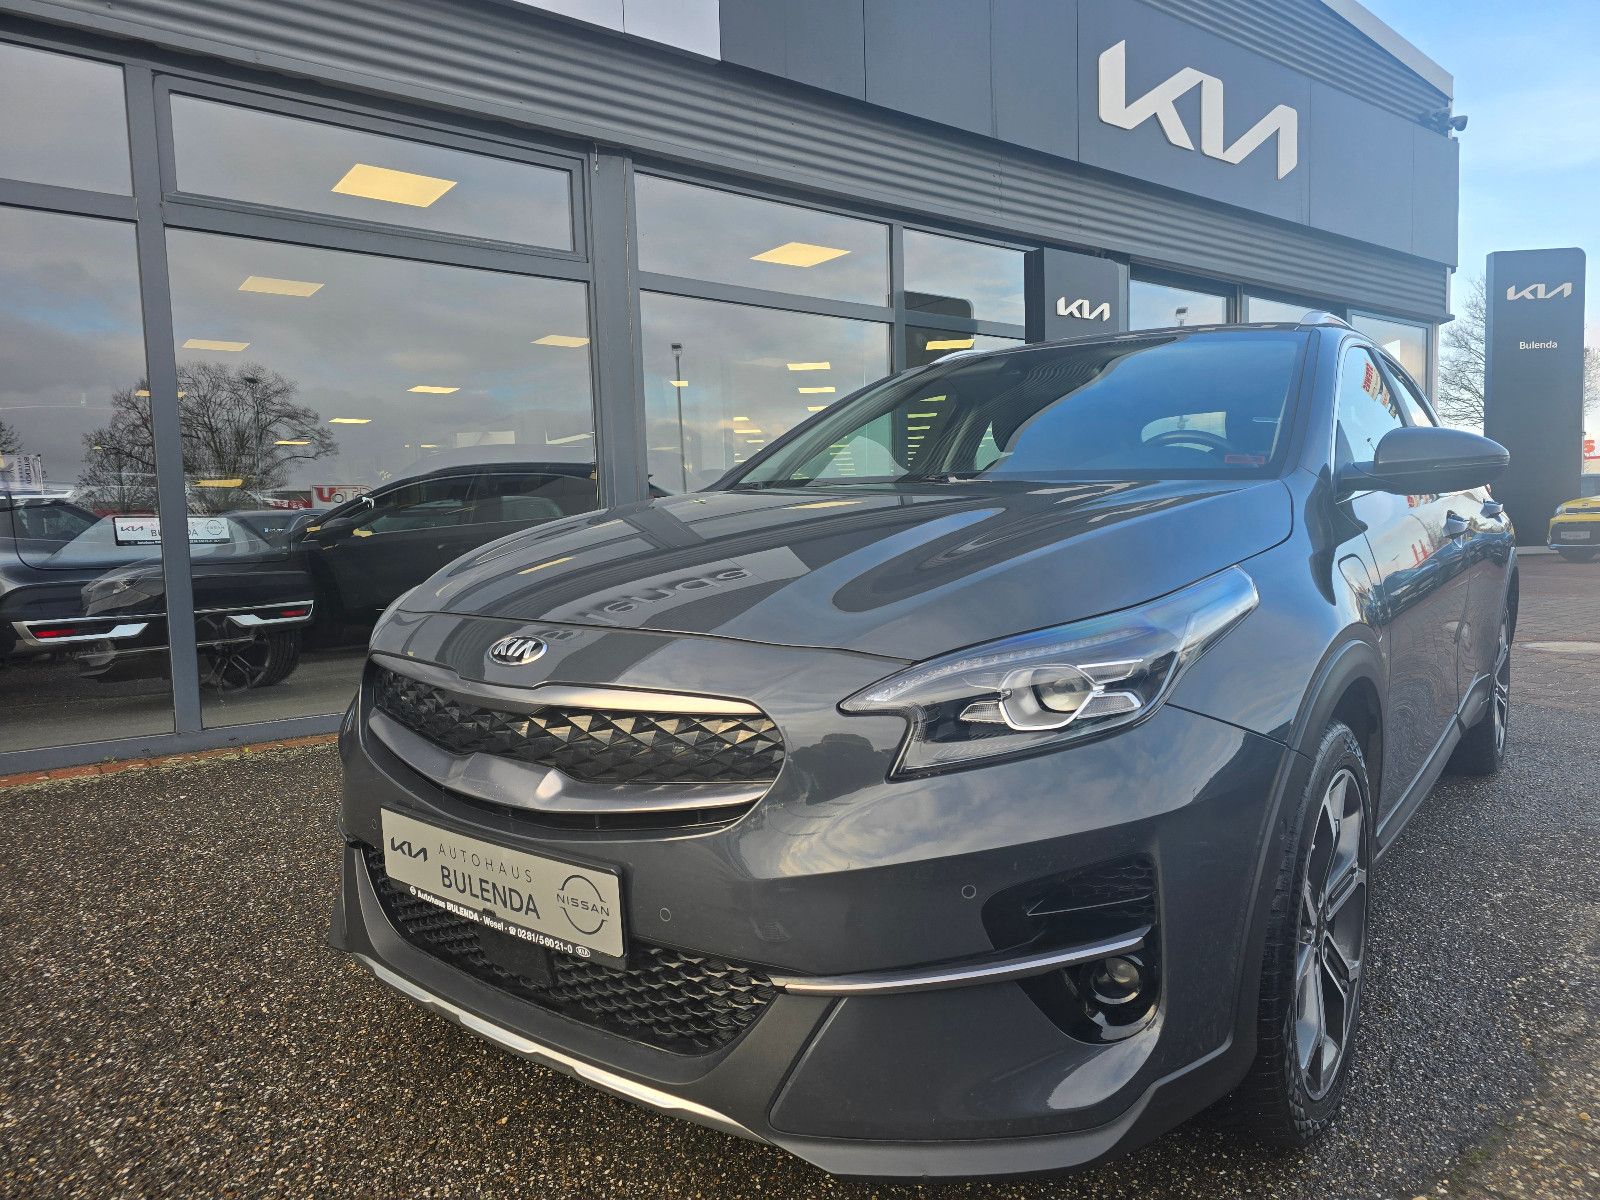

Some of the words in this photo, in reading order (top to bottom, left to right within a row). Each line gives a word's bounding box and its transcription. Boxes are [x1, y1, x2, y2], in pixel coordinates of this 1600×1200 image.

[1098, 39, 1298, 181] KIA
[1506, 282, 1572, 301] KIA
[1056, 296, 1111, 322] KIA
[1519, 340, 1558, 350] Bulenda
[493, 638, 537, 658] KIA
[390, 837, 428, 862] KIA
[438, 843, 532, 883] AUTOHAUS
[440, 864, 541, 920] BULENDA
[417, 890, 446, 909] Autohaus
[446, 901, 479, 922] BULENDA
[482, 915, 504, 931] Wesel
[556, 893, 610, 917] NISSAN
